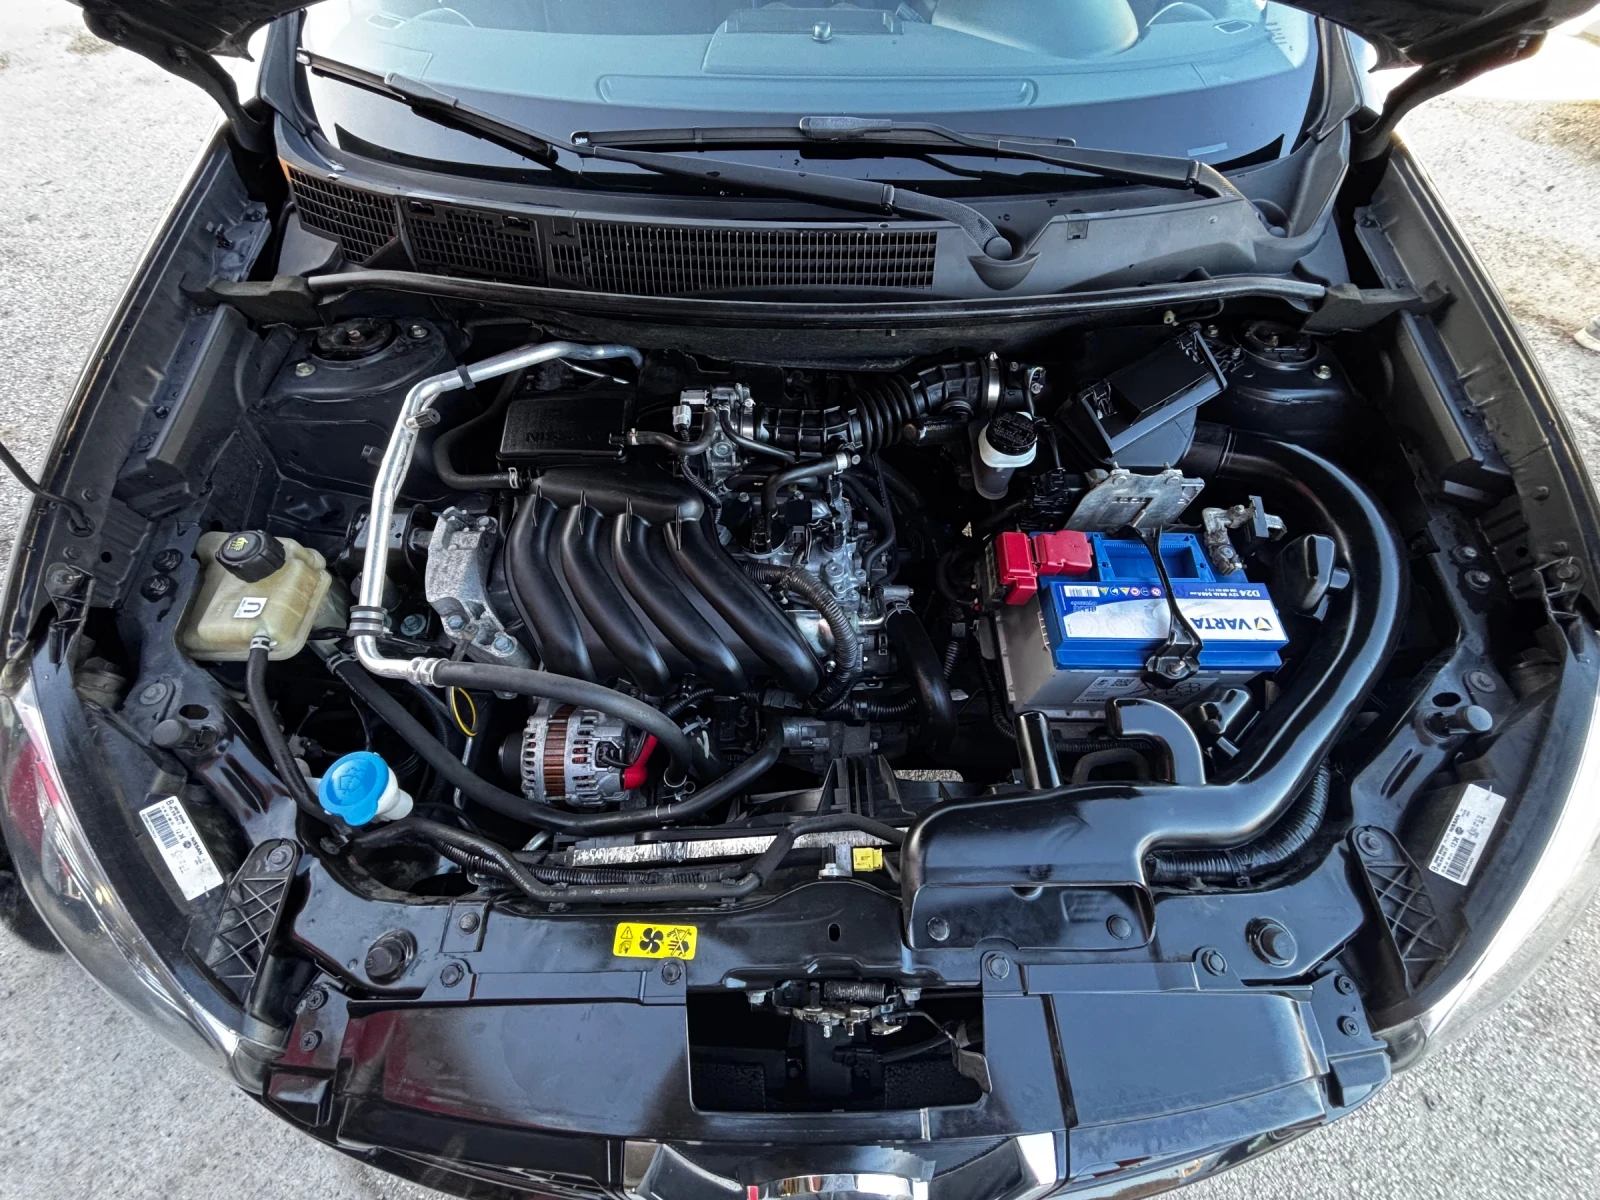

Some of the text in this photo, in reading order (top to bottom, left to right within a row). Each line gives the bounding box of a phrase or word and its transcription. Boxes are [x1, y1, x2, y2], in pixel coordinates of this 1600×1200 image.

[1239, 589, 1260, 597] D24
[1190, 617, 1252, 630] VARTA
[1449, 814, 1461, 833] NISSAN
[190, 837, 204, 856] NISSAN
